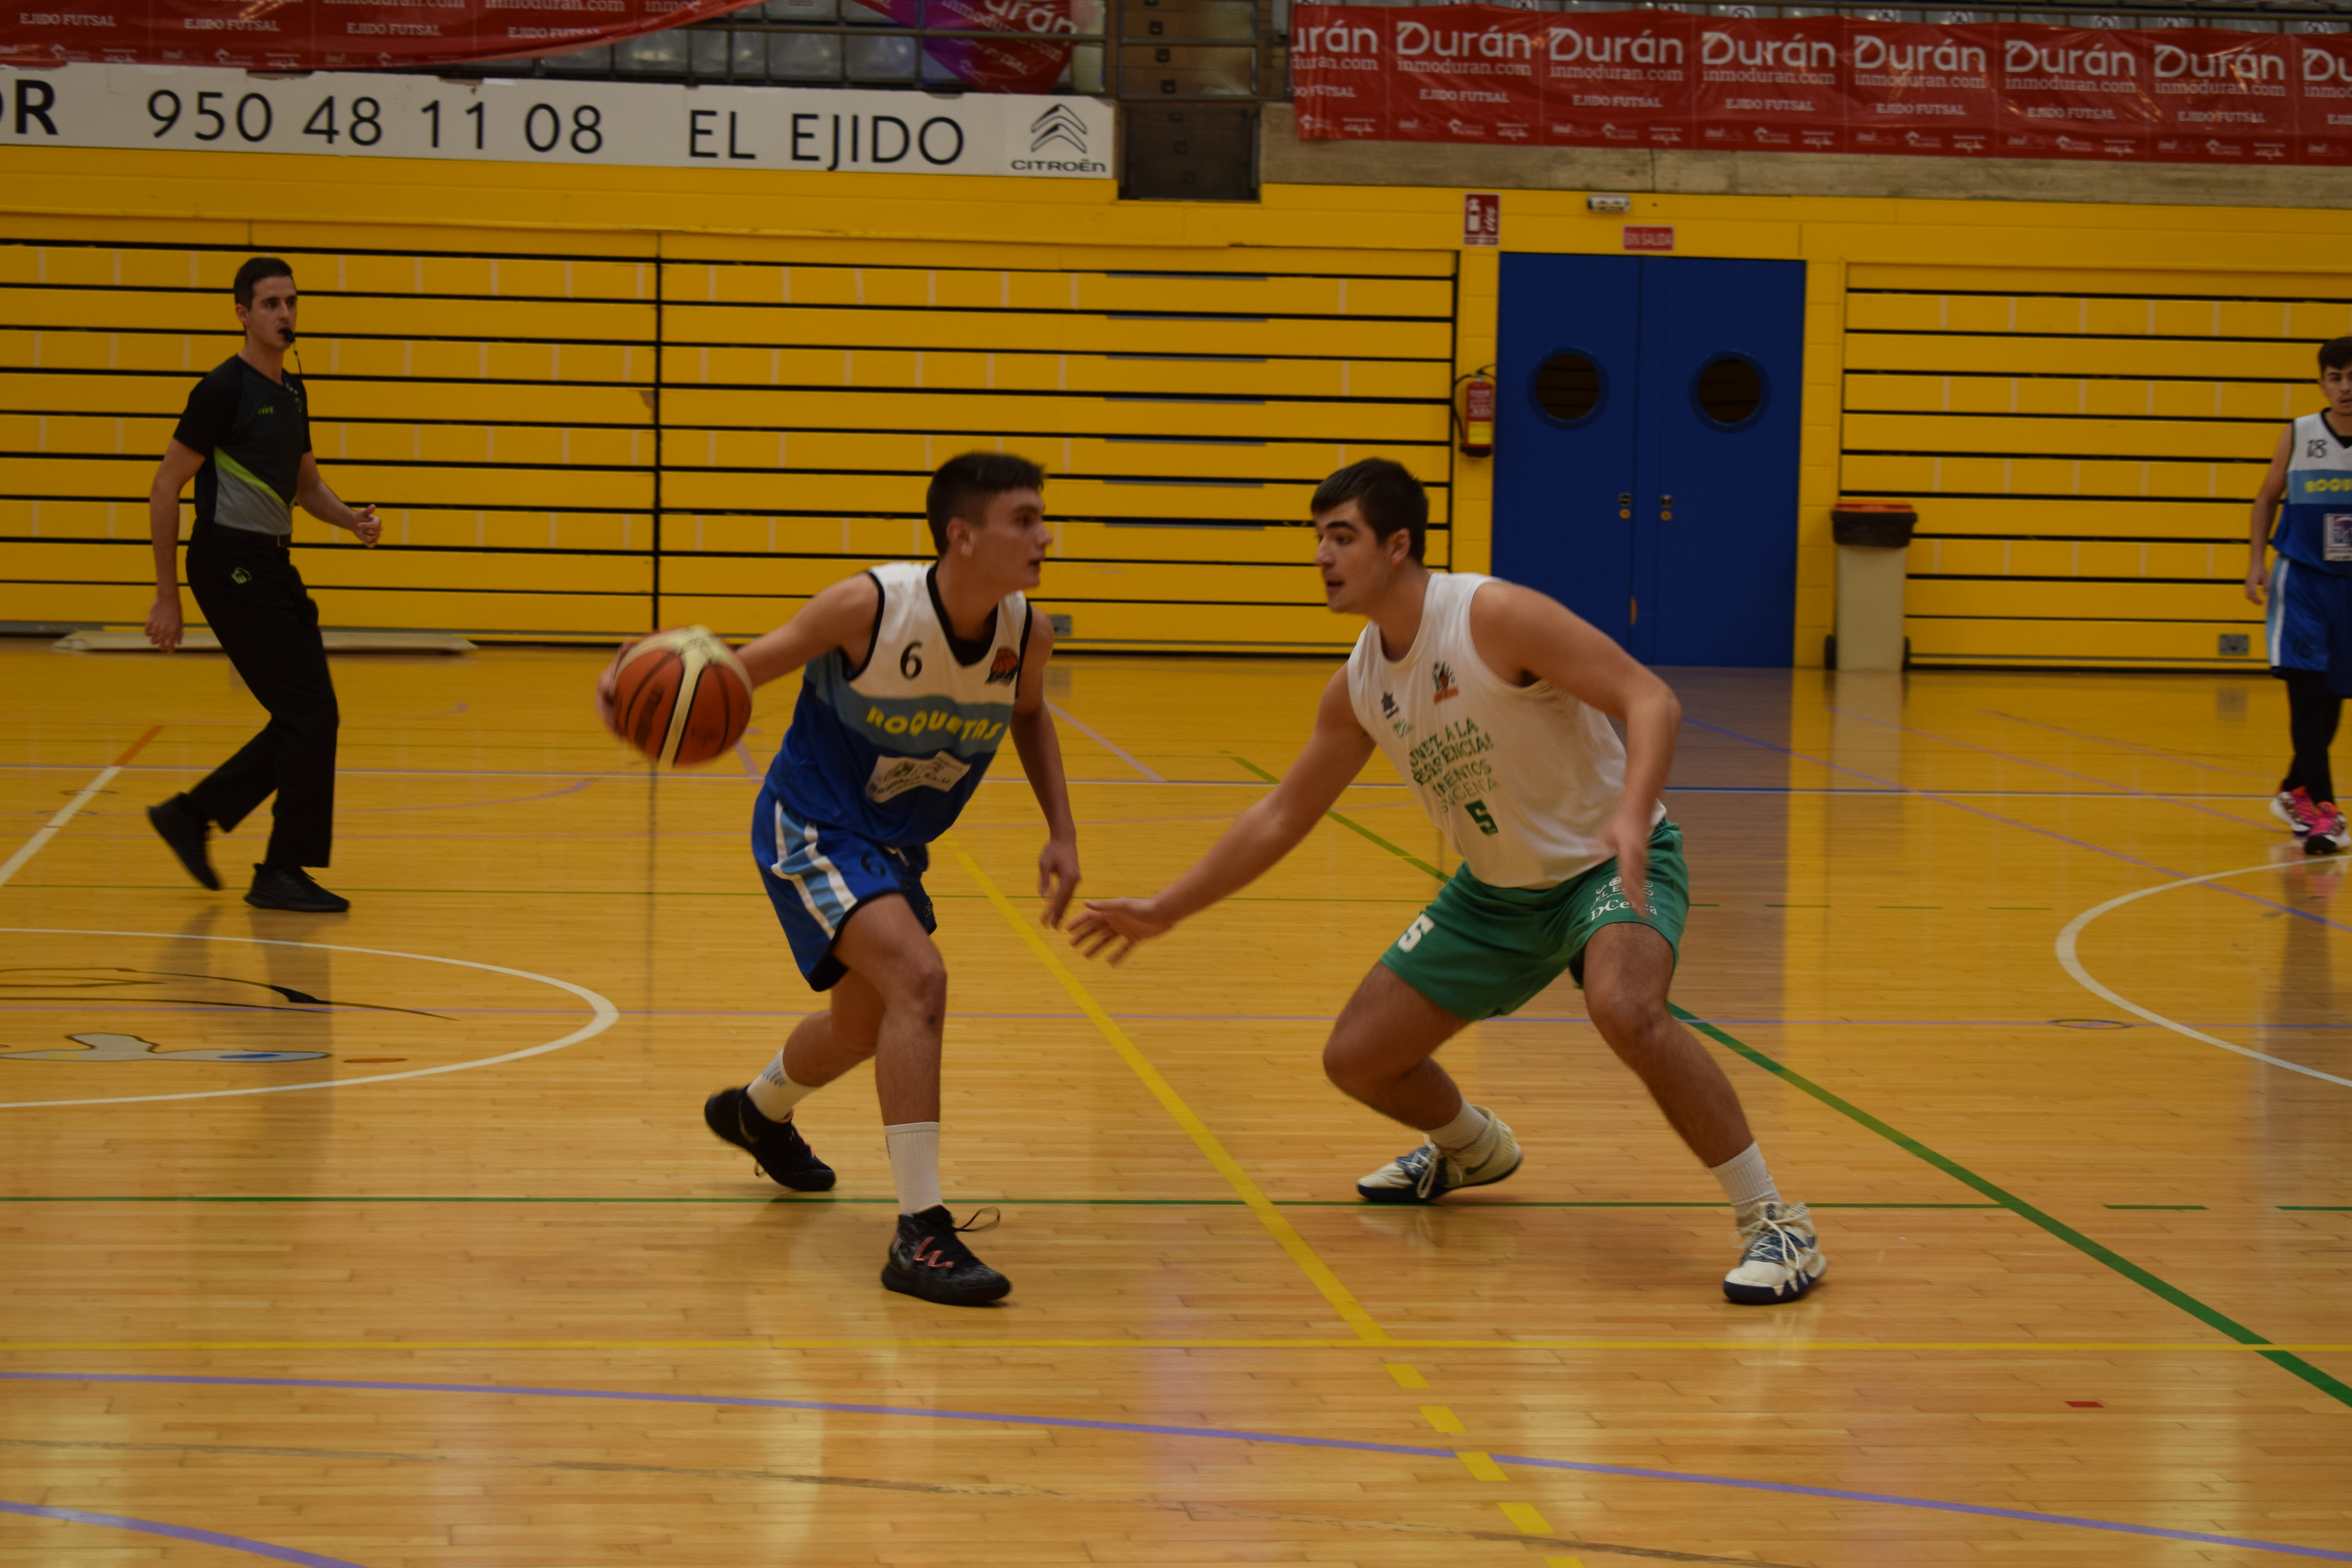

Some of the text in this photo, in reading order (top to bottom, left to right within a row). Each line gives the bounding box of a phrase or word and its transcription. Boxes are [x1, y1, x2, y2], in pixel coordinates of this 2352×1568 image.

[20, 13, 117, 27] EJIDO FUTSAL
[183, 18, 280, 32] EJIDO FUTSAL
[347, 22, 442, 36] EJIDO FUTSAL
[508, 26, 548, 38] EJIDO
[1396, 21, 1530, 58] Durán
[1549, 27, 1684, 65] Durán
[1701, 31, 1836, 68] Durán
[1854, 35, 1987, 71] Durán
[2004, 40, 2136, 76] Durán
[2154, 45, 2286, 80] Durán
[1397, 59, 1531, 76] inmoduran.com
[1550, 63, 1683, 81] inmoduran.com
[1702, 67, 1836, 85] inmoduran.com
[1855, 72, 1987, 89] inmoduran.com
[2005, 75, 2136, 93] inmoduran.com
[2155, 79, 2287, 97] inmoduran.com
[1310, 84, 1357, 98] FUTSAL
[1419, 88, 1509, 103] EJIDO FUTSAL
[1572, 94, 1663, 108] EJIDO FUTSAL
[1725, 98, 1815, 112] EJIDO FUTSAL
[1876, 103, 1966, 116] EJIDO FUTSAL
[2027, 107, 2117, 120] EJIDO FUTSAL
[2177, 110, 2266, 123] EJIDO FUTSAL
[0, 78, 964, 172] R 950 48 11 08 EL EJIDO
[900, 641, 923, 680] 6
[1445, 724, 1456, 742] A
[1454, 717, 1479, 738] LA
[1465, 799, 1498, 836] 5
[1397, 912, 1435, 953] 5
